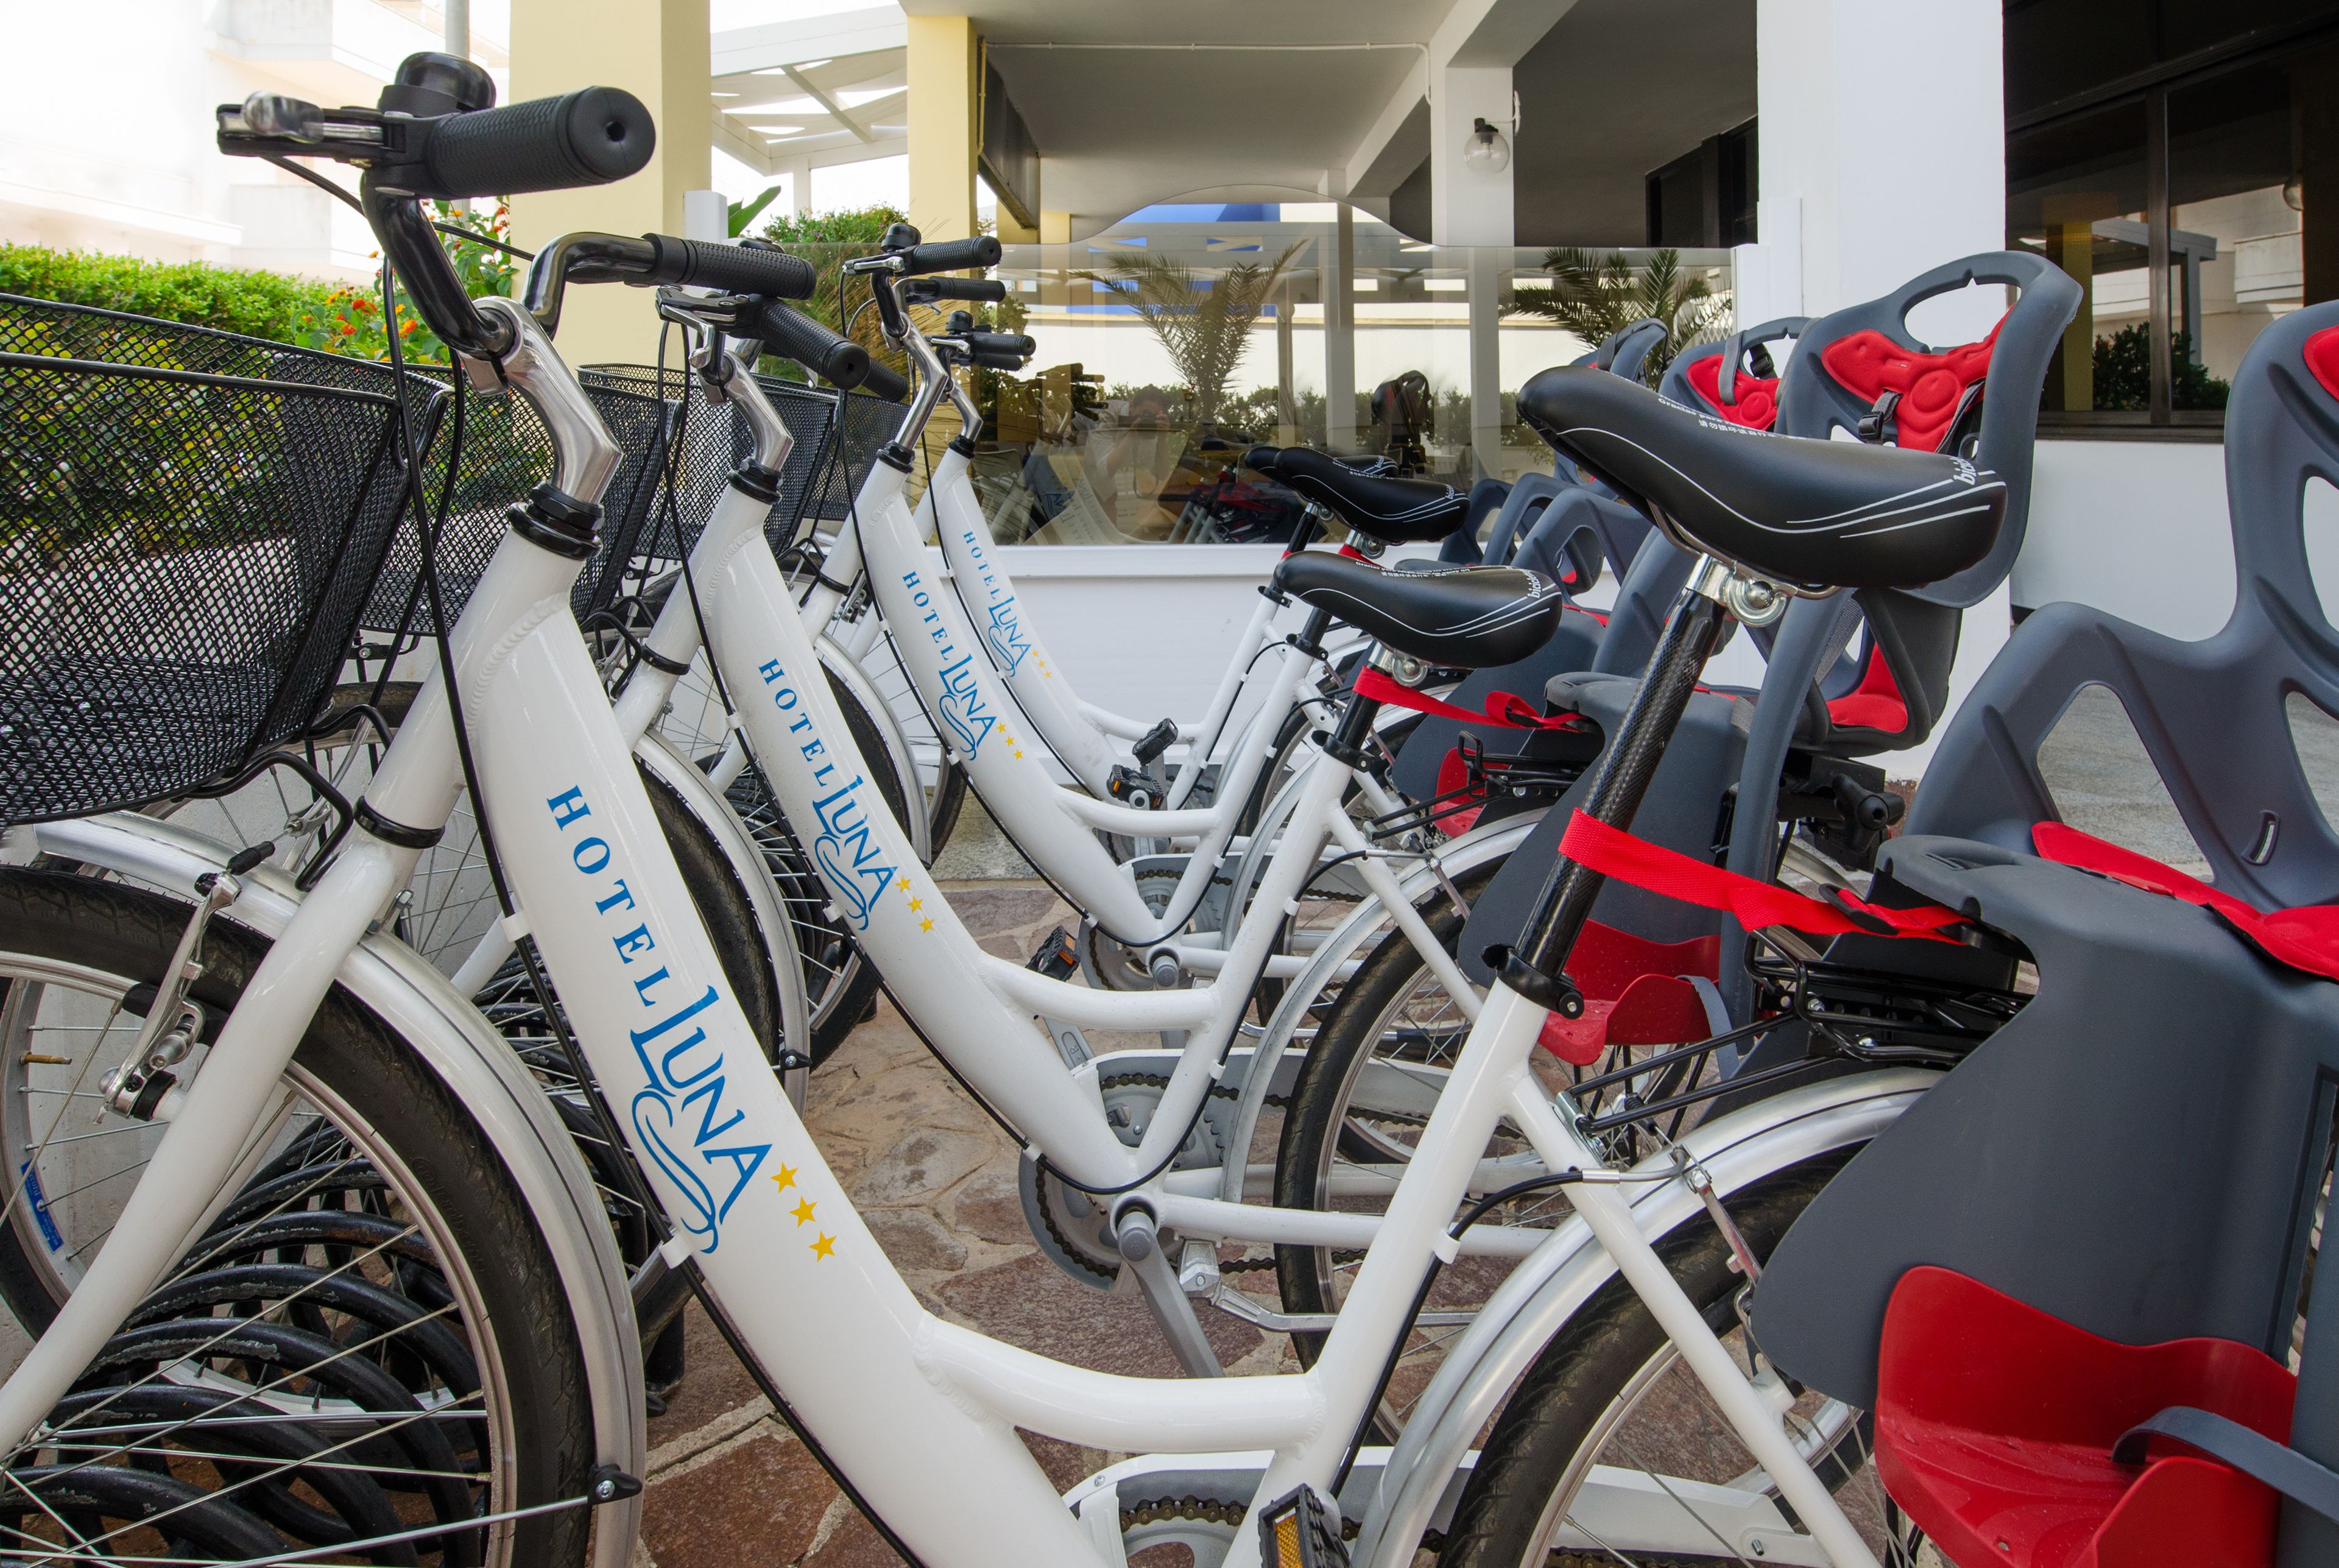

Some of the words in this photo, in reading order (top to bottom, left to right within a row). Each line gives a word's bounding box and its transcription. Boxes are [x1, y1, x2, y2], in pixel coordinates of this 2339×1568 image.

[902, 570, 954, 656] HOTEL
[938, 652, 997, 748] LUNA
[962, 531, 1000, 599] HOTEL
[988, 595, 1032, 667] LUNA
[758, 657, 835, 787] HOTEL
[811, 774, 898, 913] LUNA
[546, 784, 671, 1008] HOTEL
[630, 984, 773, 1224] LUNA
